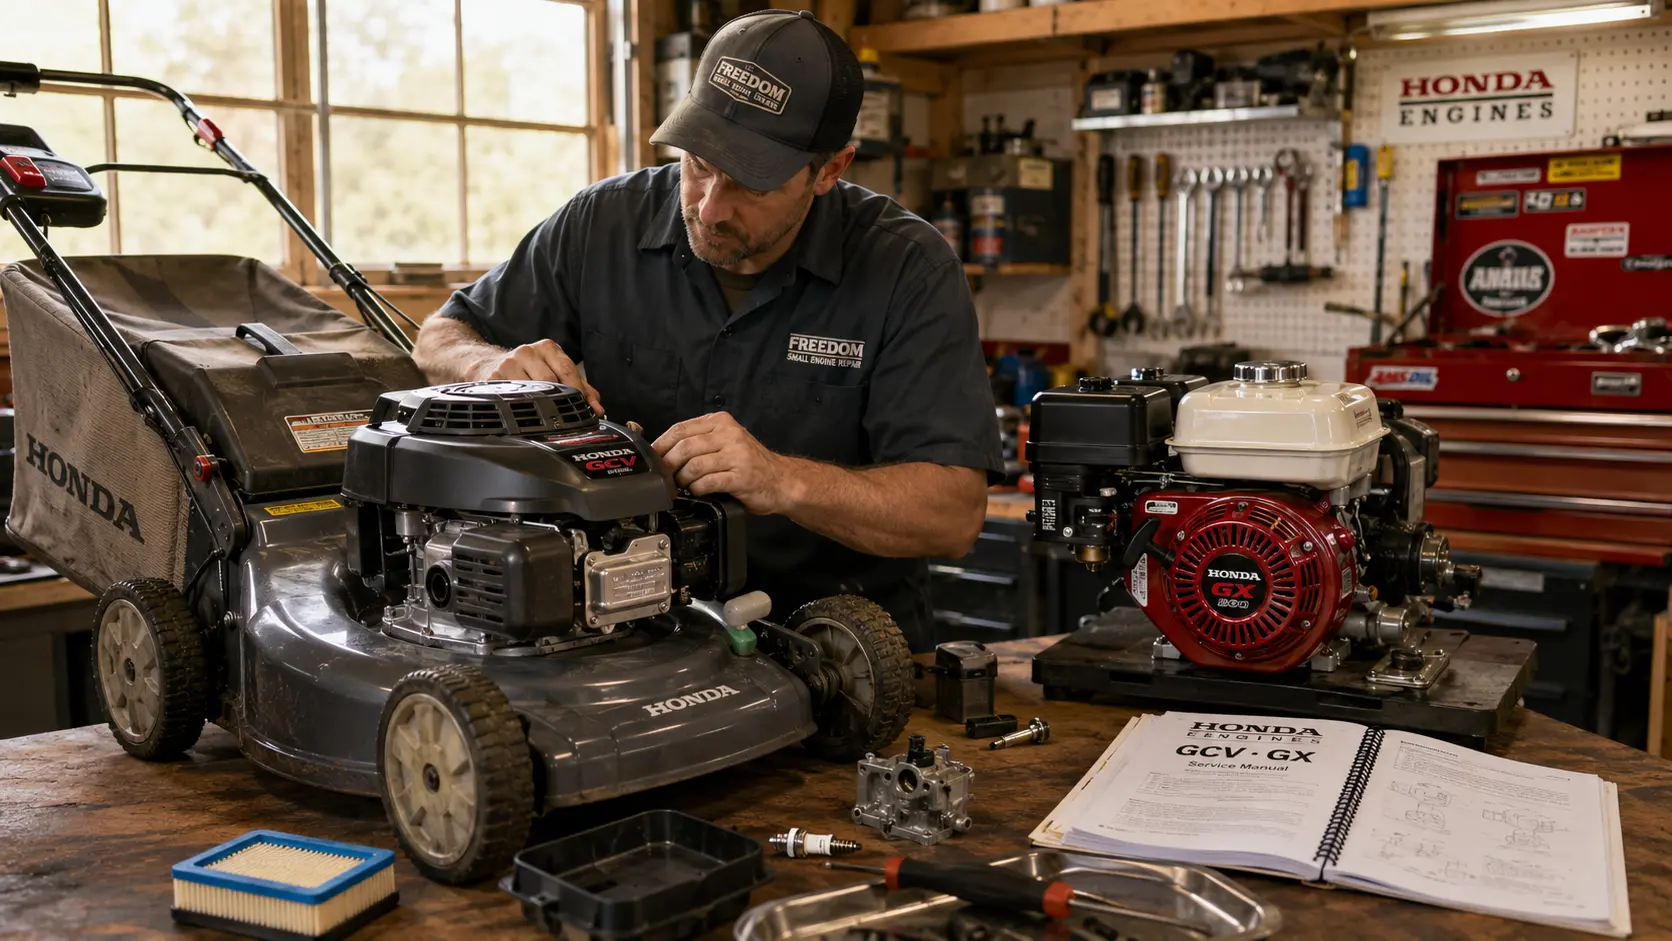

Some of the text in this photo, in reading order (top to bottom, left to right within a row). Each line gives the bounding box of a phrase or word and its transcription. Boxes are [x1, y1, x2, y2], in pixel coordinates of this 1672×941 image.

[716, 61, 786, 101] FREEDOM
[1400, 69, 1554, 97] HONDA
[1399, 102, 1553, 126] ENGINES
[789, 336, 864, 357] FREEDOM
[786, 353, 809, 363] SMALL
[572, 448, 636, 462] HONDA
[585, 455, 637, 471] GCV
[26, 432, 145, 545] HONDA
[1207, 569, 1261, 581] HONDA
[1211, 581, 1257, 599] GX
[642, 685, 740, 717] HONDA
[1190, 721, 1323, 736] HONDA
[1175, 744, 1247, 758] GCV
[1266, 749, 1316, 763] GX
[1188, 760, 1289, 771] Service Manual
